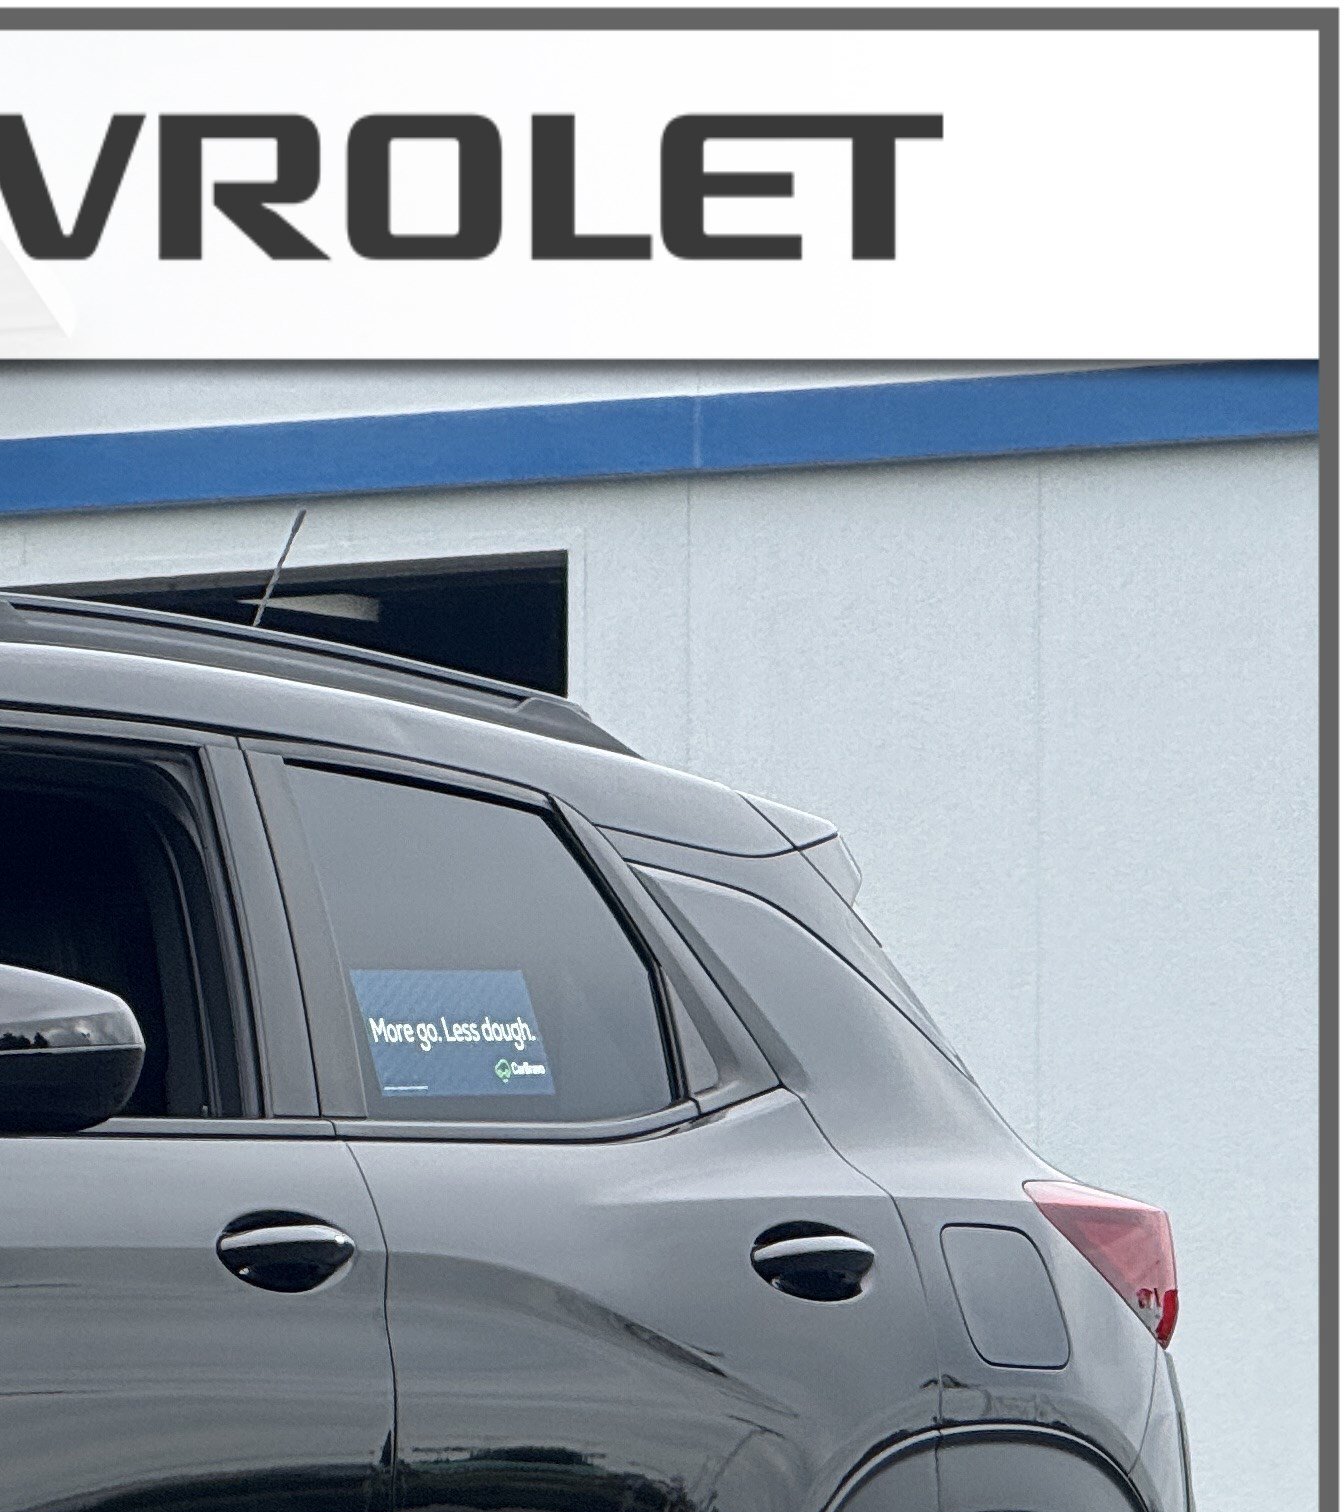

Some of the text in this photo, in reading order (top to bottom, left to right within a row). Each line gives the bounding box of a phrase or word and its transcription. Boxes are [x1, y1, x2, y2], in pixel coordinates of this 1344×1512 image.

[368, 1016, 537, 1051] More go. Less dough.
